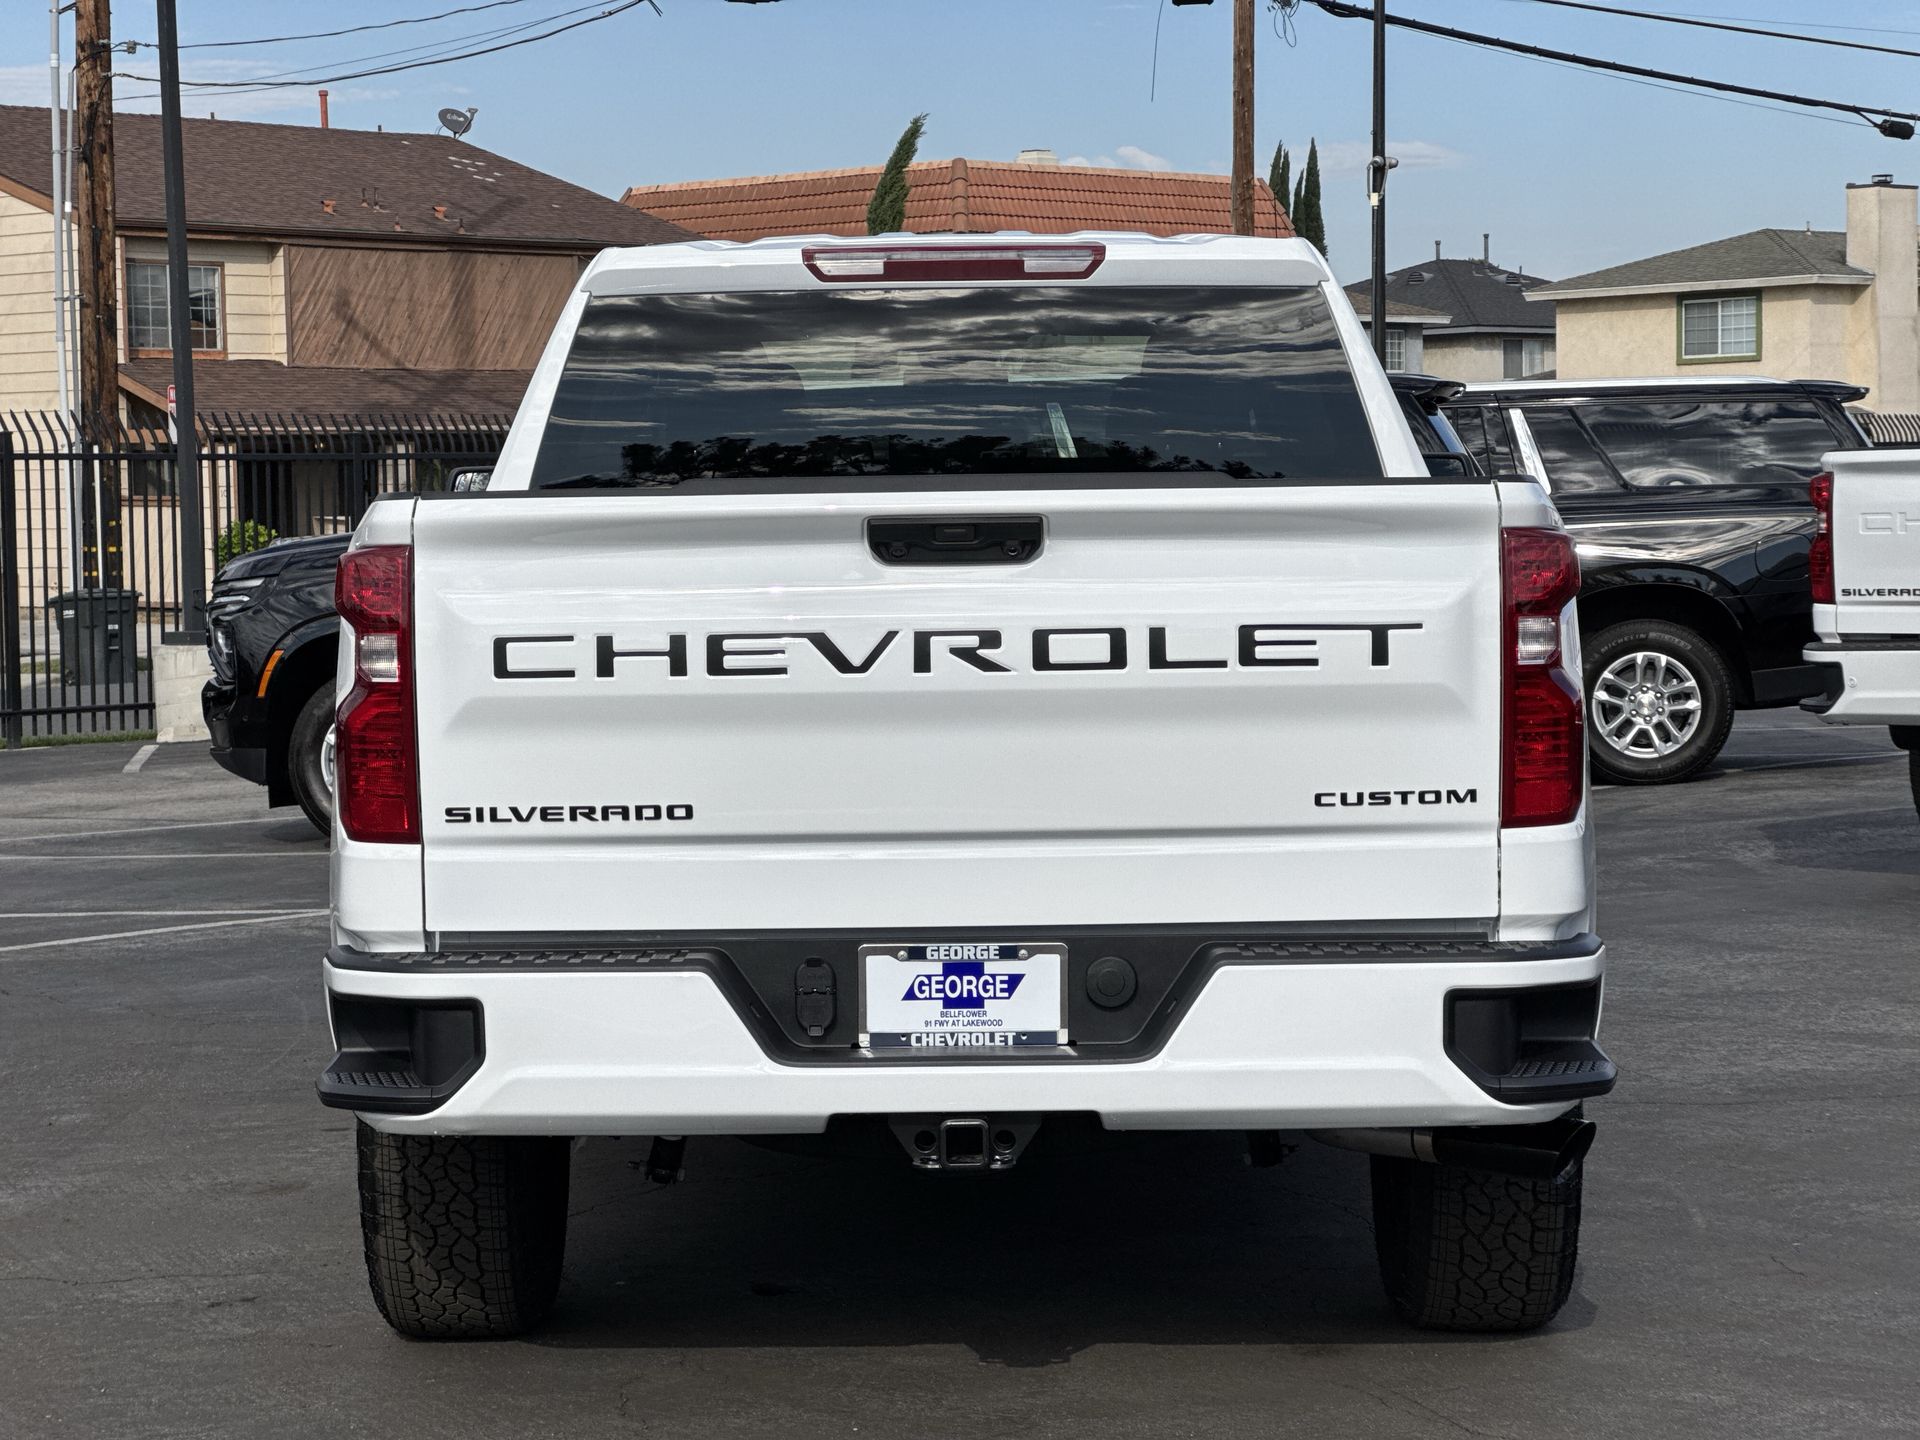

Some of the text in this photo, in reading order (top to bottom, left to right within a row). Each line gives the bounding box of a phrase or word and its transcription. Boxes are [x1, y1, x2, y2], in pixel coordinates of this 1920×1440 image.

[492, 623, 1424, 679] CHEVROLET
[1313, 788, 1478, 807] CUSTOM
[444, 803, 694, 824] SILVERADO
[926, 945, 1000, 960] GEORGE
[913, 975, 1009, 999] GEORGE
[940, 1010, 987, 1018] BELLFLOWER
[951, 1019, 961, 1027] AT
[962, 1019, 1003, 1027] LAKEWOOD
[910, 1032, 1016, 1047] CHEVROLET
